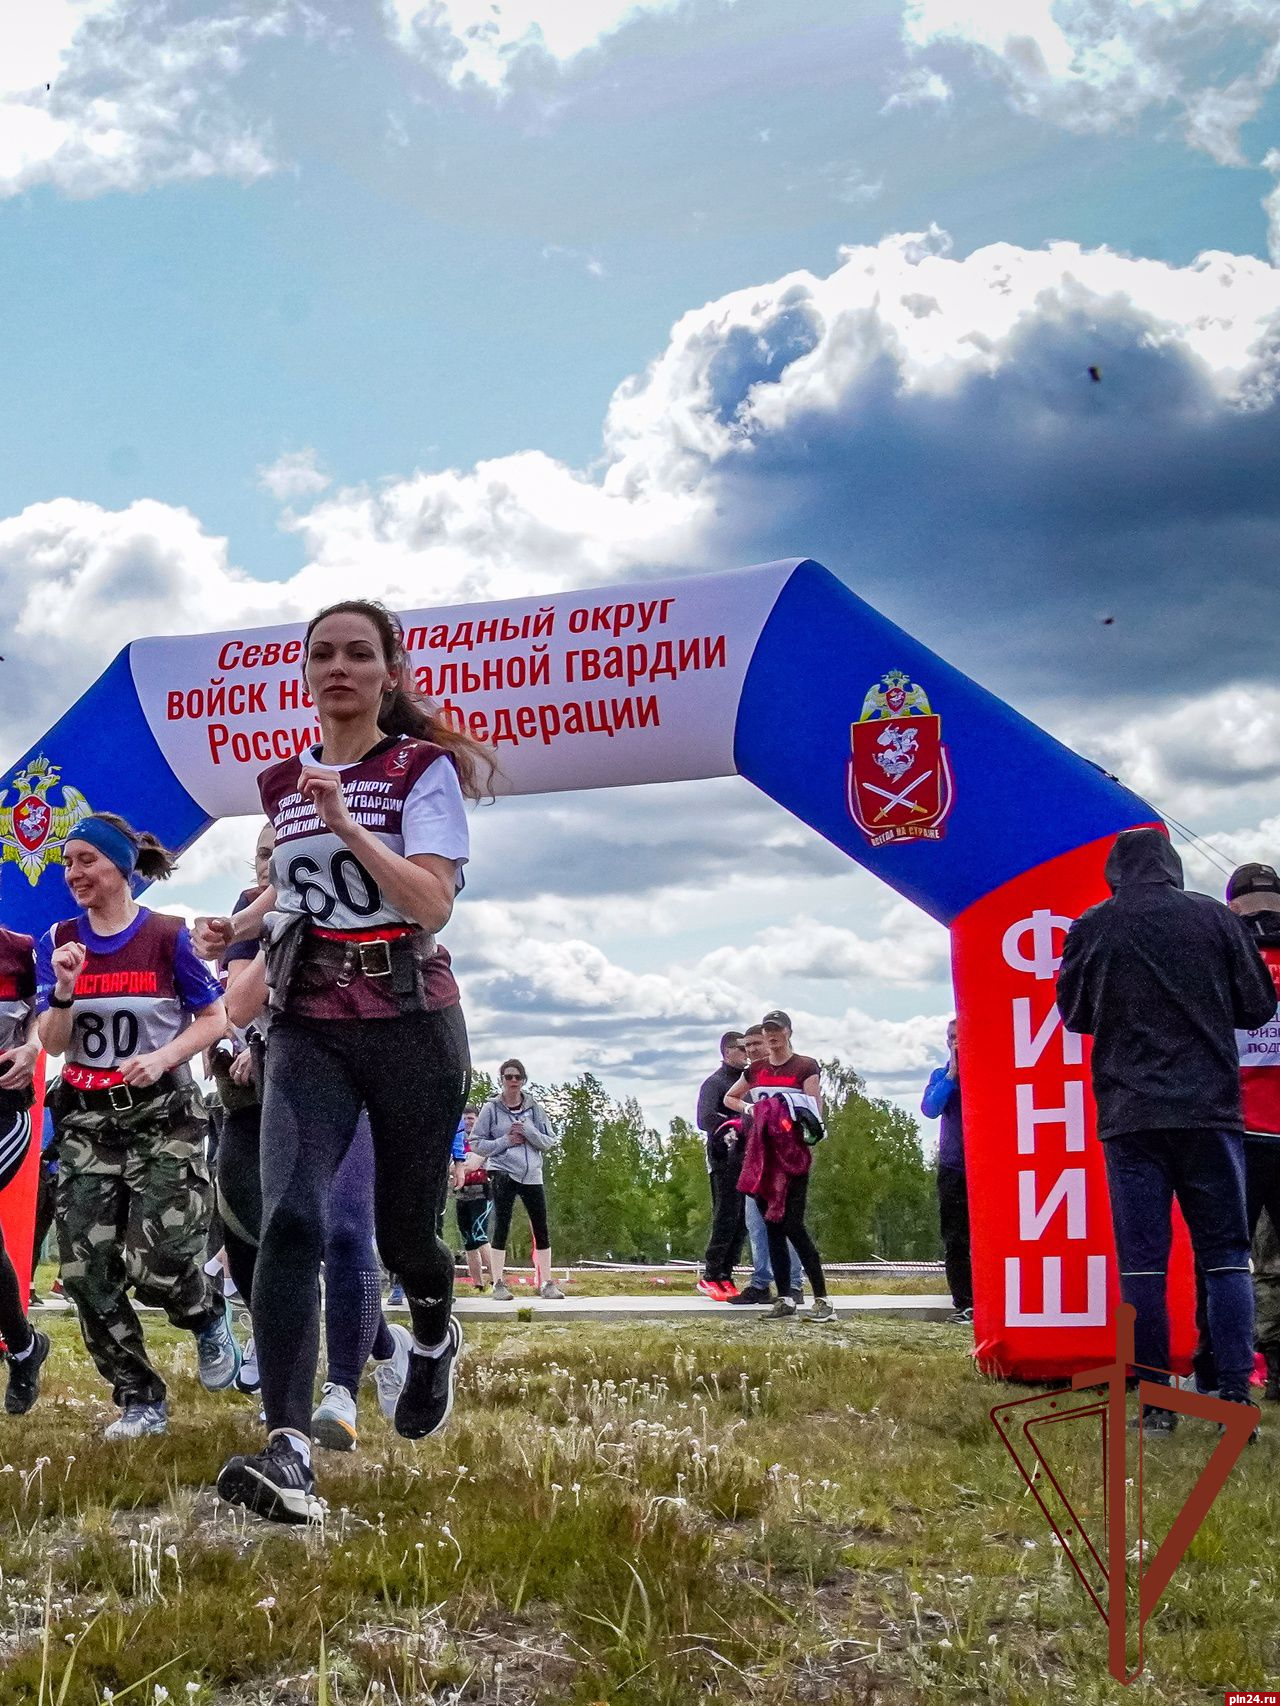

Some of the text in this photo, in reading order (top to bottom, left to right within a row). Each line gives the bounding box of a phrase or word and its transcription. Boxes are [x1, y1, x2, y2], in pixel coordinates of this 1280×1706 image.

[569, 599, 676, 637] округ
[167, 677, 267, 720] войск
[566, 635, 726, 687] гвардии
[354, 794, 403, 812] ГВАРДИИ
[356, 780, 393, 794] ОКРУГ
[288, 848, 383, 921] 60
[76, 1009, 139, 1060] 80
[1001, 908, 1107, 1328] ФИНИШ
